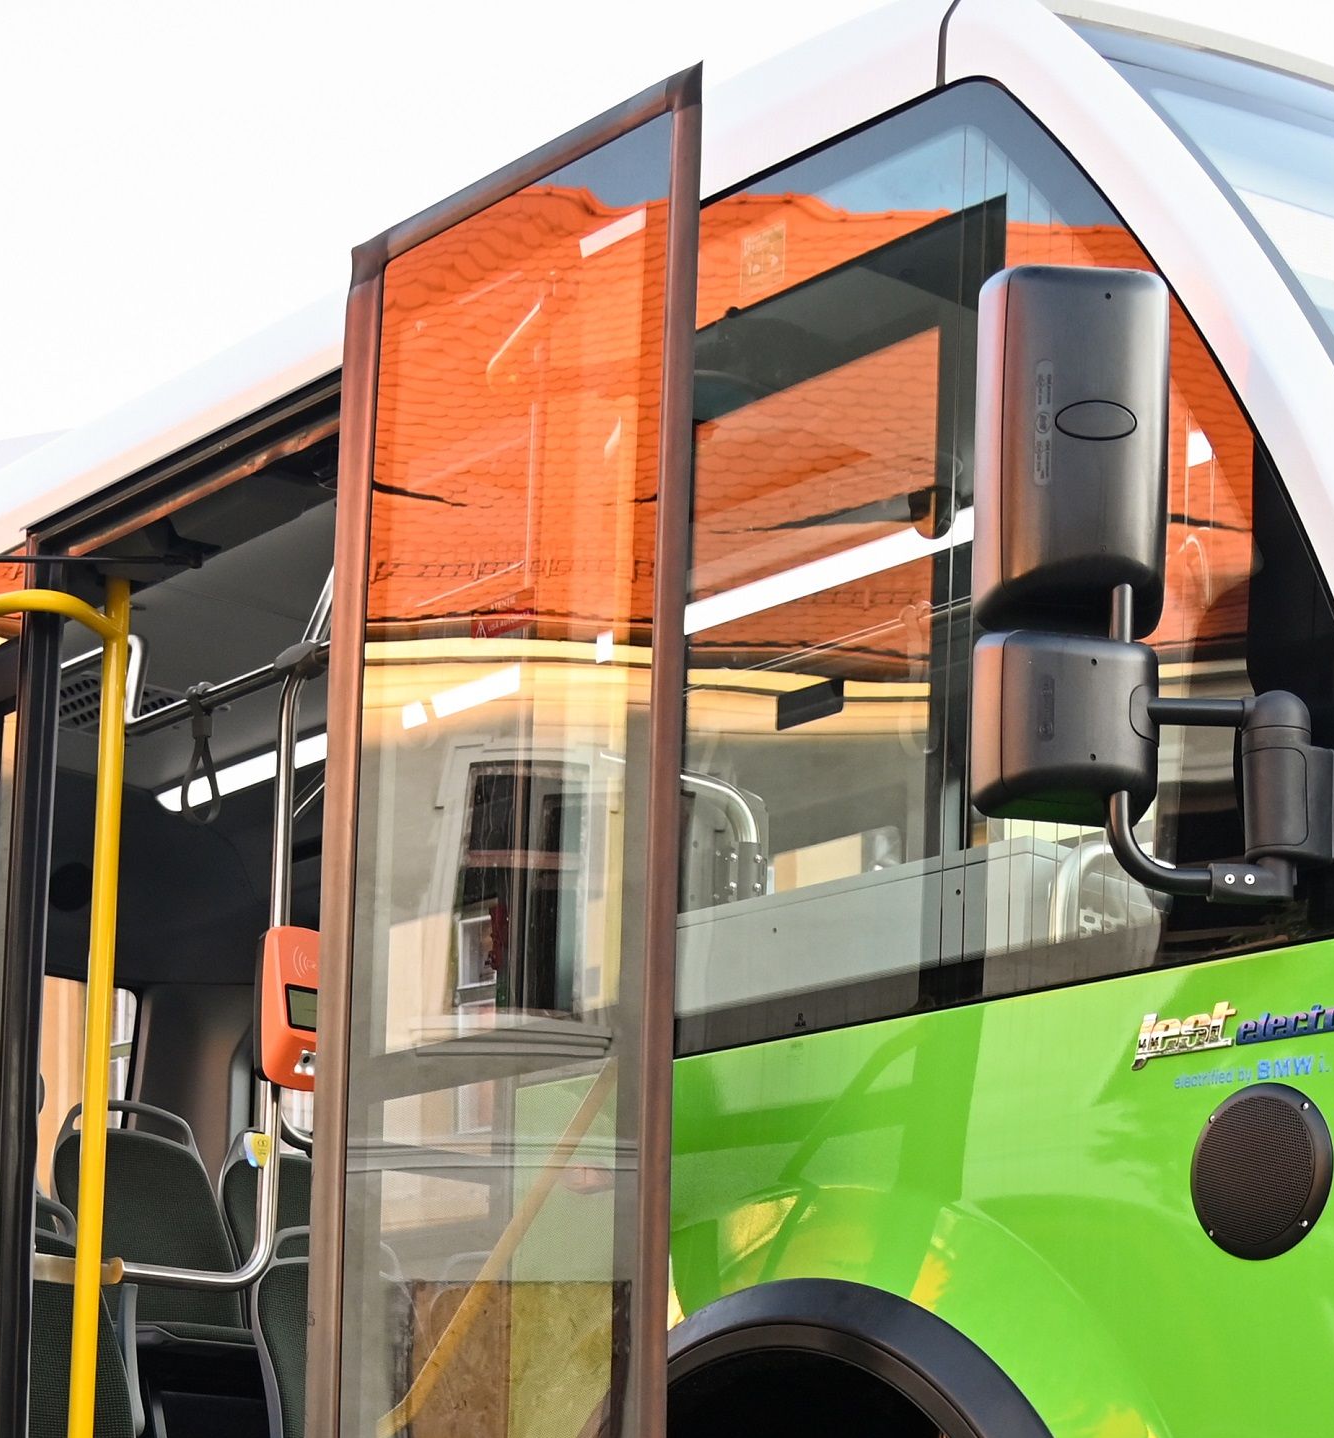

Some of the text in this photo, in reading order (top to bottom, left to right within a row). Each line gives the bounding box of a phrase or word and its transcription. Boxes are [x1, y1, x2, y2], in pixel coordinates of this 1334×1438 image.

[1174, 1068, 1233, 1089] electrified
[1238, 1066, 1252, 1082] by
[1257, 1055, 1314, 1080] BMW
